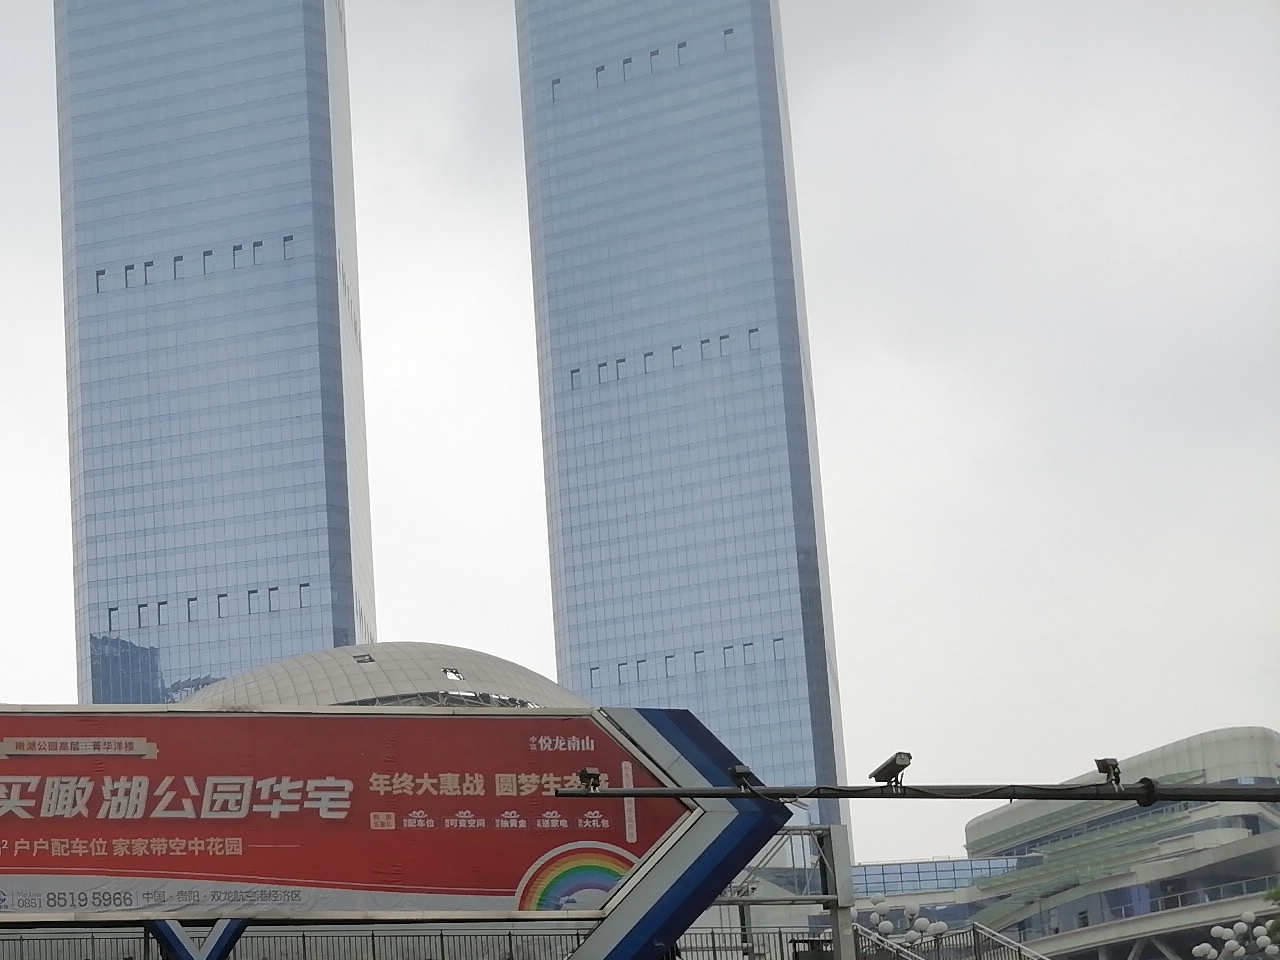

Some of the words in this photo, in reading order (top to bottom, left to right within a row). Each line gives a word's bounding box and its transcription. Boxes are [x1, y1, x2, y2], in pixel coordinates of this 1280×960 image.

[538, 736, 595, 752] 悦龙南山
[369, 773, 486, 797] 年终大惠战
[14, 838, 109, 857] 户户配车位
[113, 837, 244, 857] 家家带空中花园
[17, 898, 43, 909] 0851
[46, 892, 89, 908] 8519
[92, 891, 134, 908] 5966
